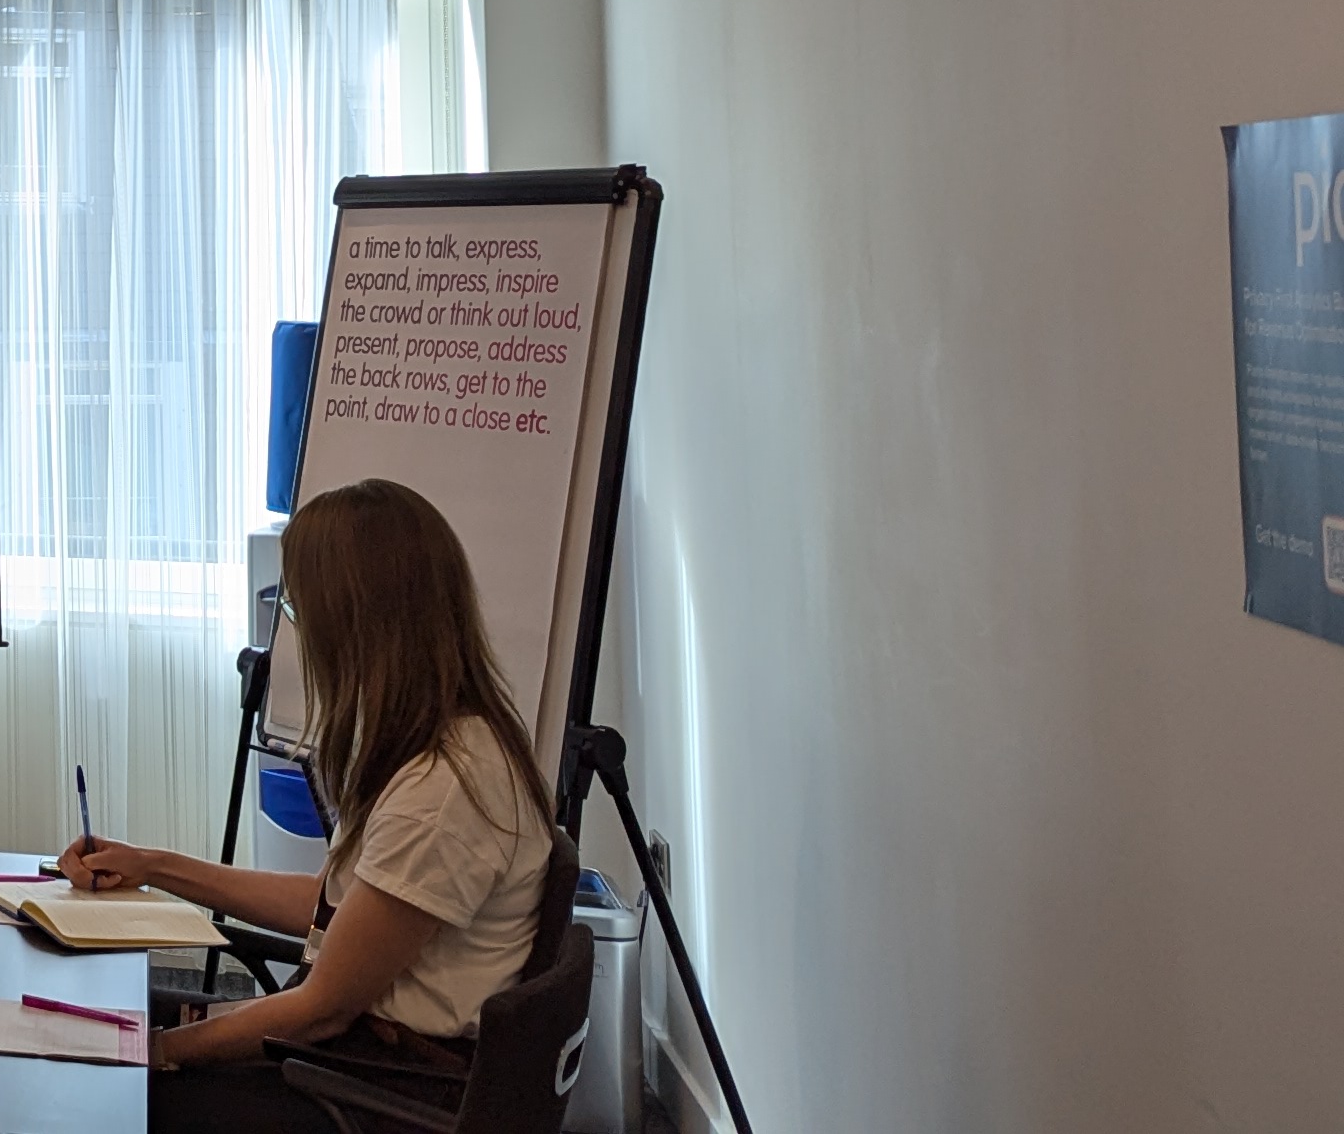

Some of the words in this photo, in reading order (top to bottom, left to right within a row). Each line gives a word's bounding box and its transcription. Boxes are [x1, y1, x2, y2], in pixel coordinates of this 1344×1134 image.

[349, 242, 360, 259] a
[364, 235, 400, 259] time
[405, 236, 421, 259] to
[425, 234, 460, 261] talk,
[465, 239, 542, 265] express,
[344, 266, 411, 296] expand,
[415, 268, 490, 298] impress,
[495, 268, 559, 299] inspire
[340, 298, 365, 322] the
[370, 300, 424, 325] crowd
[427, 307, 446, 325] or
[450, 300, 493, 327] think
[498, 304, 528, 328] out
[534, 301, 581, 332] loud,
[334, 333, 400, 359] present,
[404, 337, 482, 364] propose,
[488, 336, 568, 364] address
[330, 362, 356, 386] the
[360, 362, 401, 389] back
[405, 371, 451, 395] rows,
[455, 370, 488, 399] get
[492, 371, 511, 396] to
[515, 371, 547, 398] the
[325, 394, 369, 422] point,
[374, 396, 420, 423] draw
[423, 401, 440, 425] to
[444, 408, 458, 426] a
[462, 402, 511, 431] close
[515, 409, 551, 434] etc.
